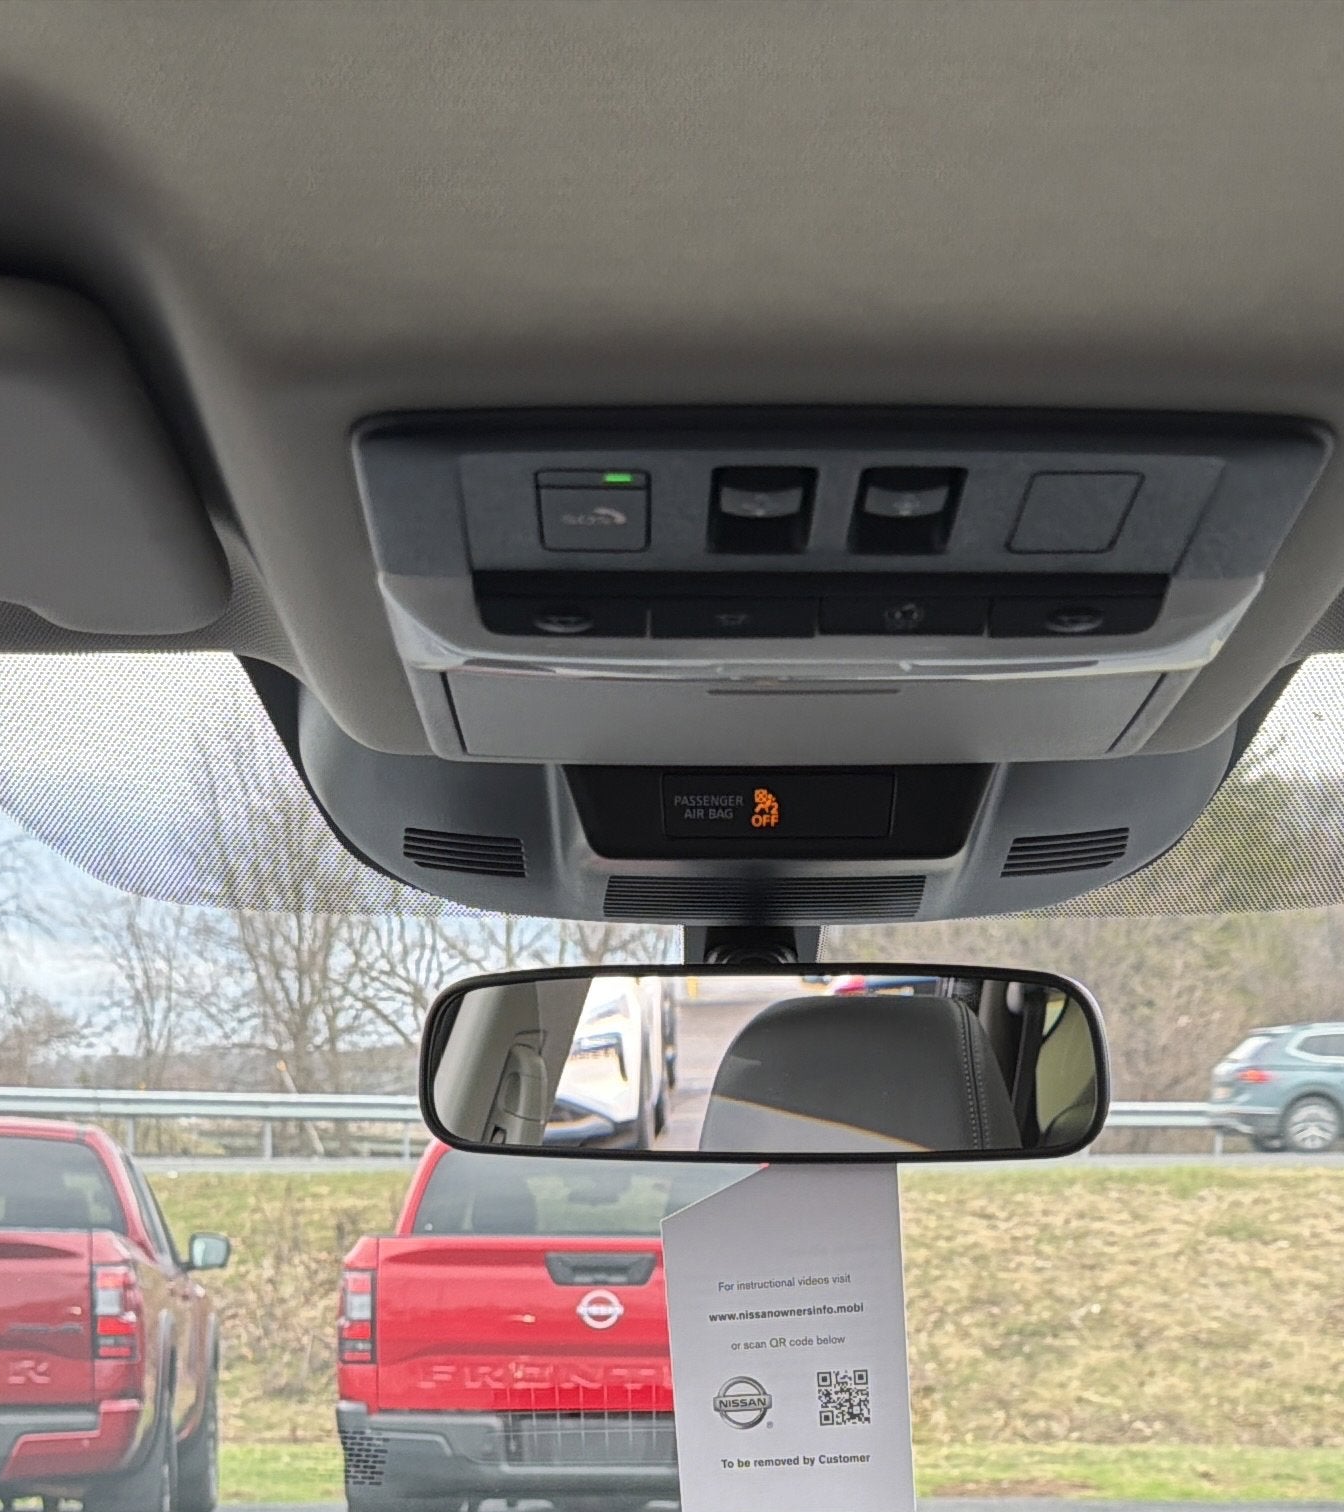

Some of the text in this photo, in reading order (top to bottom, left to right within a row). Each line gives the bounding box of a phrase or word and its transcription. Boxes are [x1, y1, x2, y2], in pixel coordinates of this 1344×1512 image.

[674, 796, 744, 807] PASSENGER
[684, 809, 734, 819] AIR BAG
[752, 815, 779, 827] OFF
[718, 1274, 851, 1292] For instructional videos visit
[709, 1302, 864, 1322] www.nissanownersinfo.mobi
[731, 1335, 846, 1351] or scan QR code below
[719, 1398, 767, 1408] NISSAN
[721, 1453, 870, 1469] To be removed by Customer
